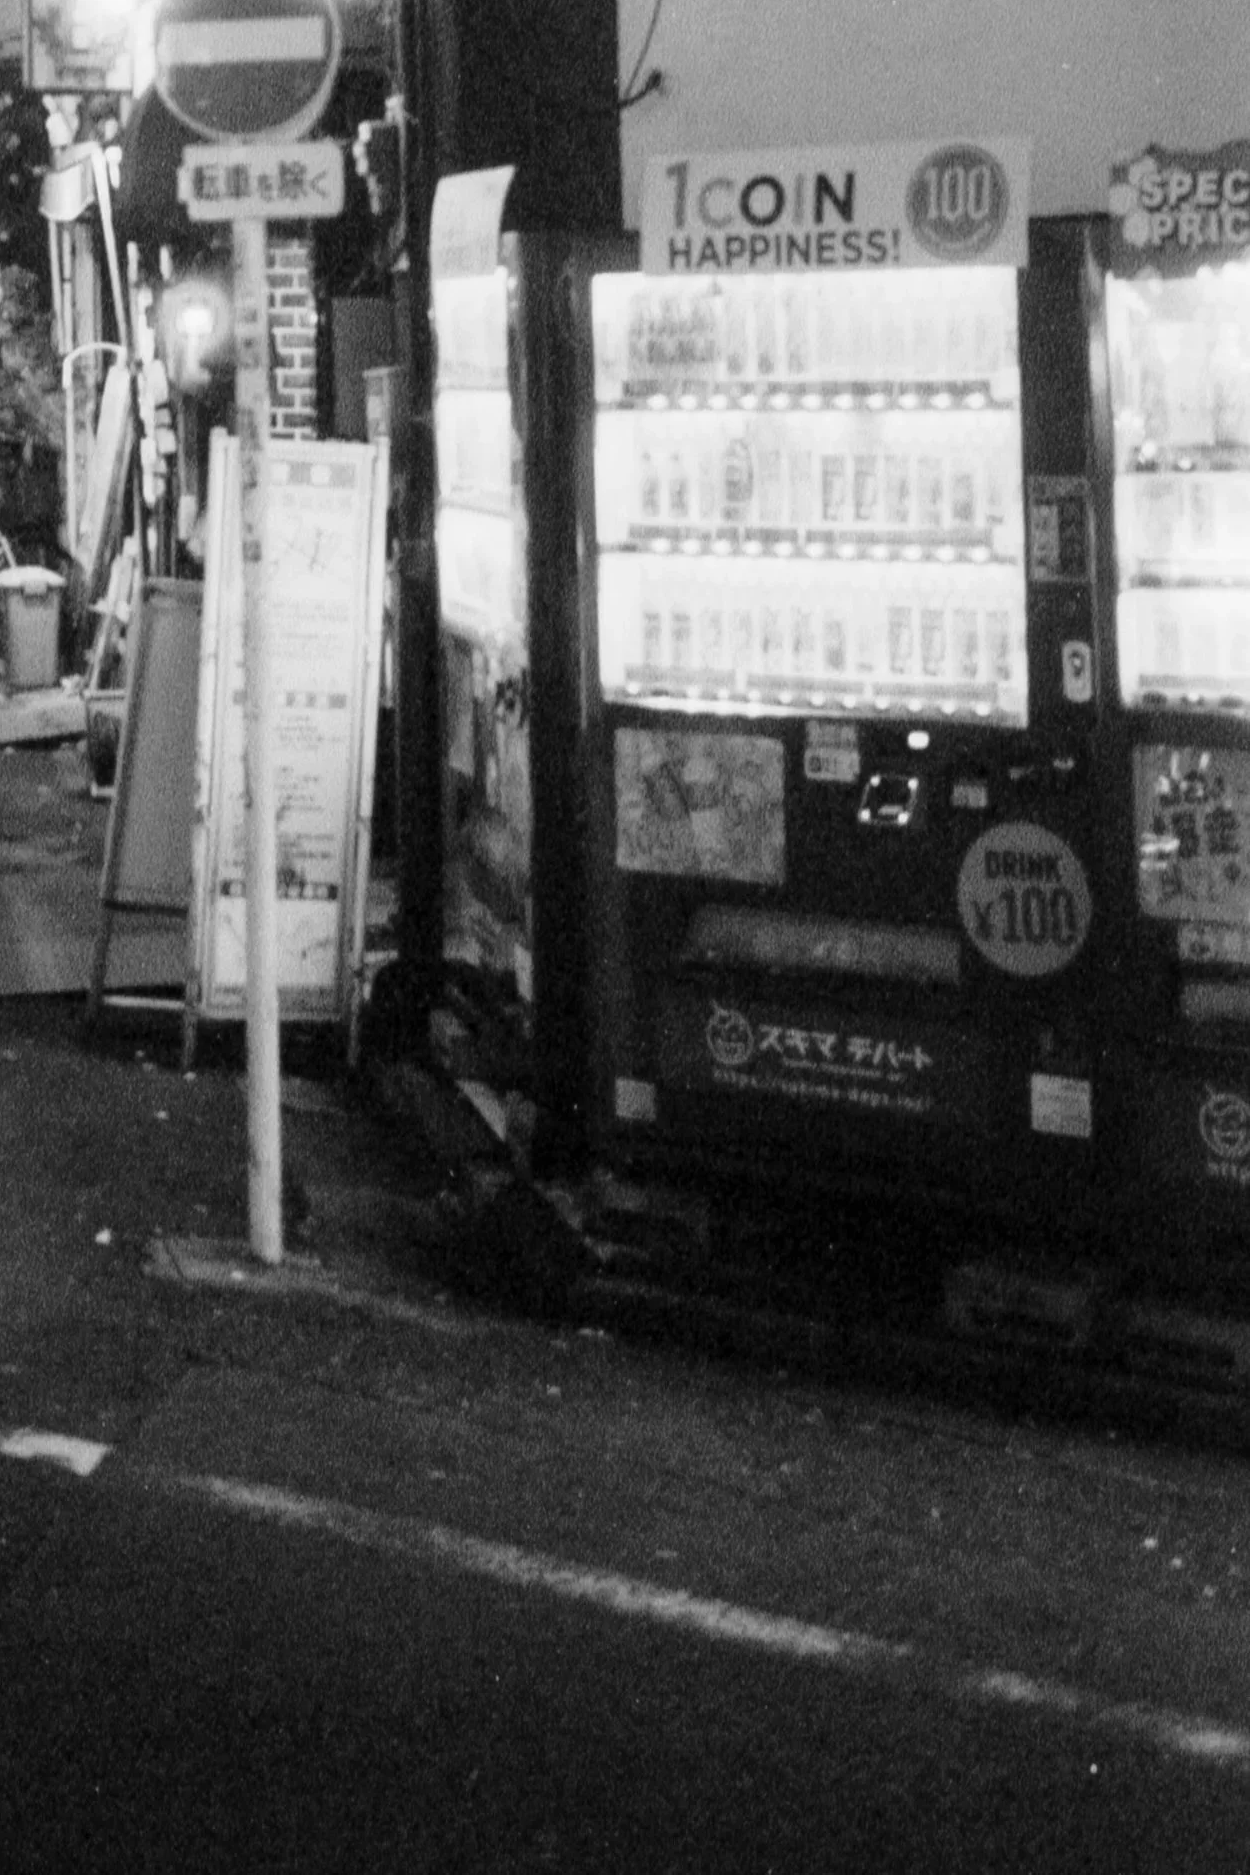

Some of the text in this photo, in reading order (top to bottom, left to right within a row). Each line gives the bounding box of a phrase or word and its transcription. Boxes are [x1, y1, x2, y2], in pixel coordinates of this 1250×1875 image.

[923, 164, 992, 224] 100
[669, 229, 901, 270] HAPPINESS!
[985, 850, 1063, 883] DRINK
